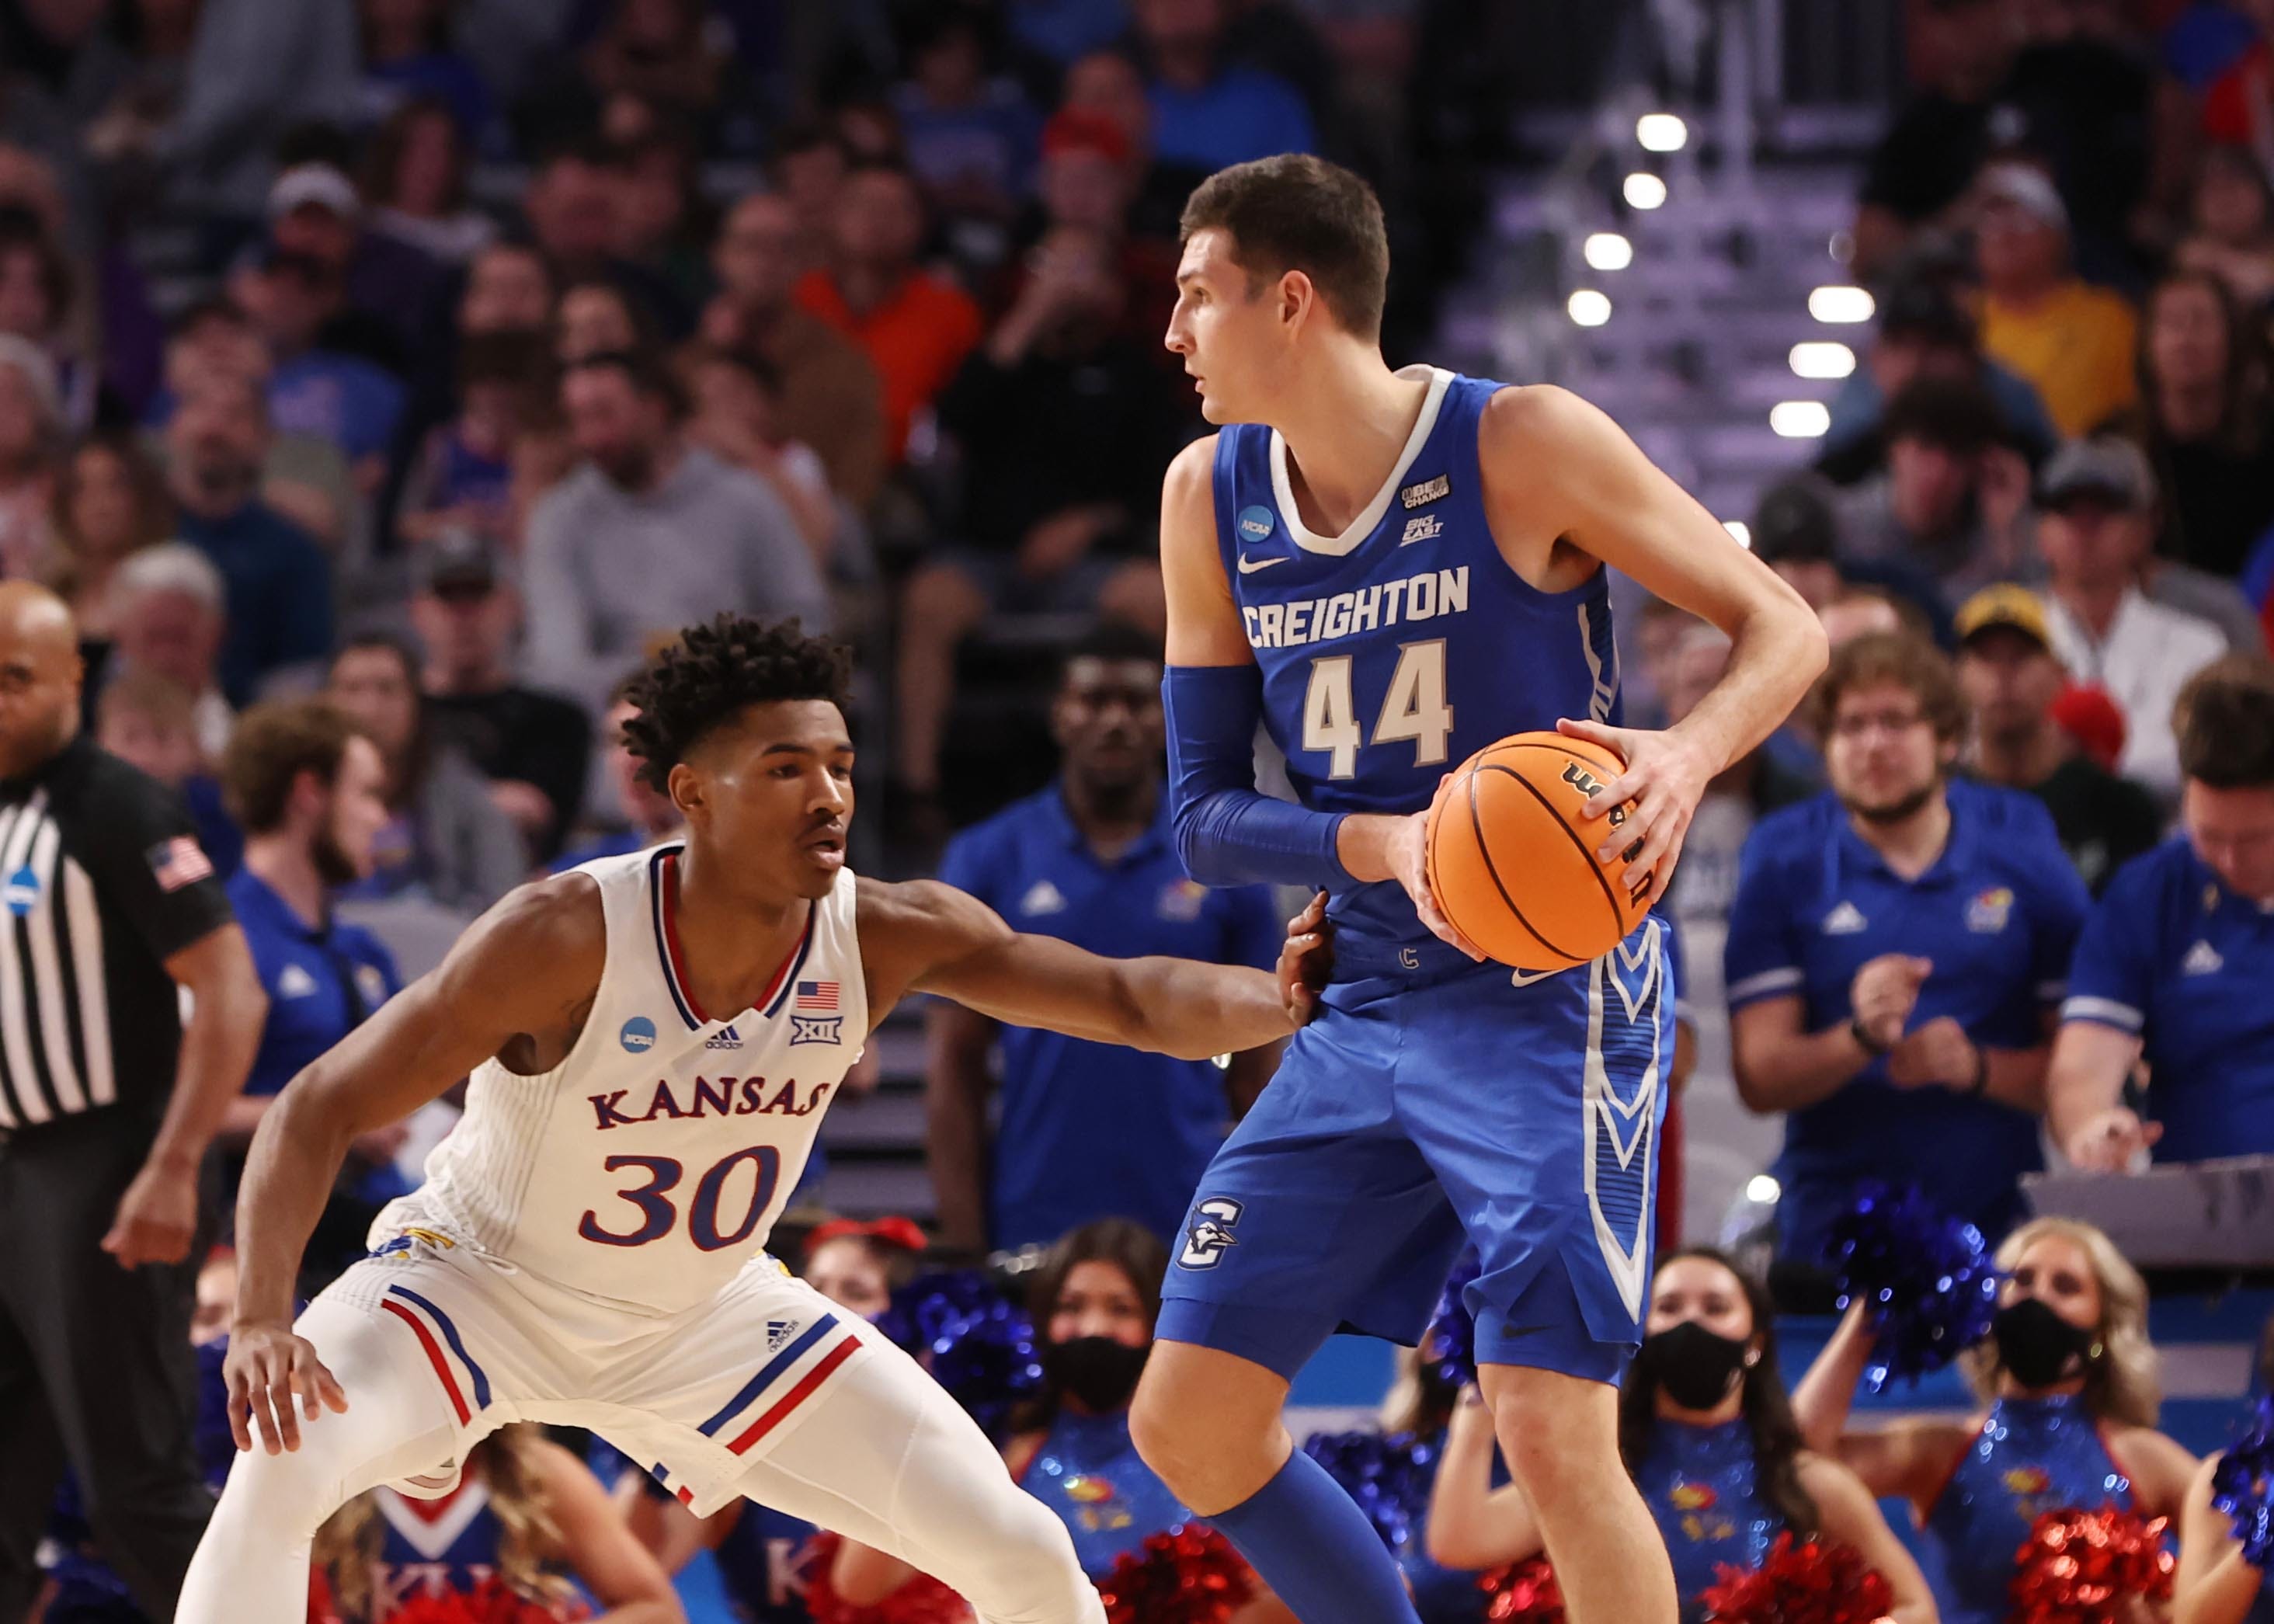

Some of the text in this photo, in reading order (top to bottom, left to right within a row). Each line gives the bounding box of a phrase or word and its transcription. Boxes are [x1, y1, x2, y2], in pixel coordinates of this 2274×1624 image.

[1402, 522, 1445, 541] EAST
[1405, 513, 1436, 531] BIG
[1243, 565, 1469, 649] CREIGHTON
[1302, 638, 1455, 781] 44
[587, 1076, 831, 1130] KANSAS
[579, 1145, 781, 1252] 30
[768, 1319, 800, 1353] adidas
